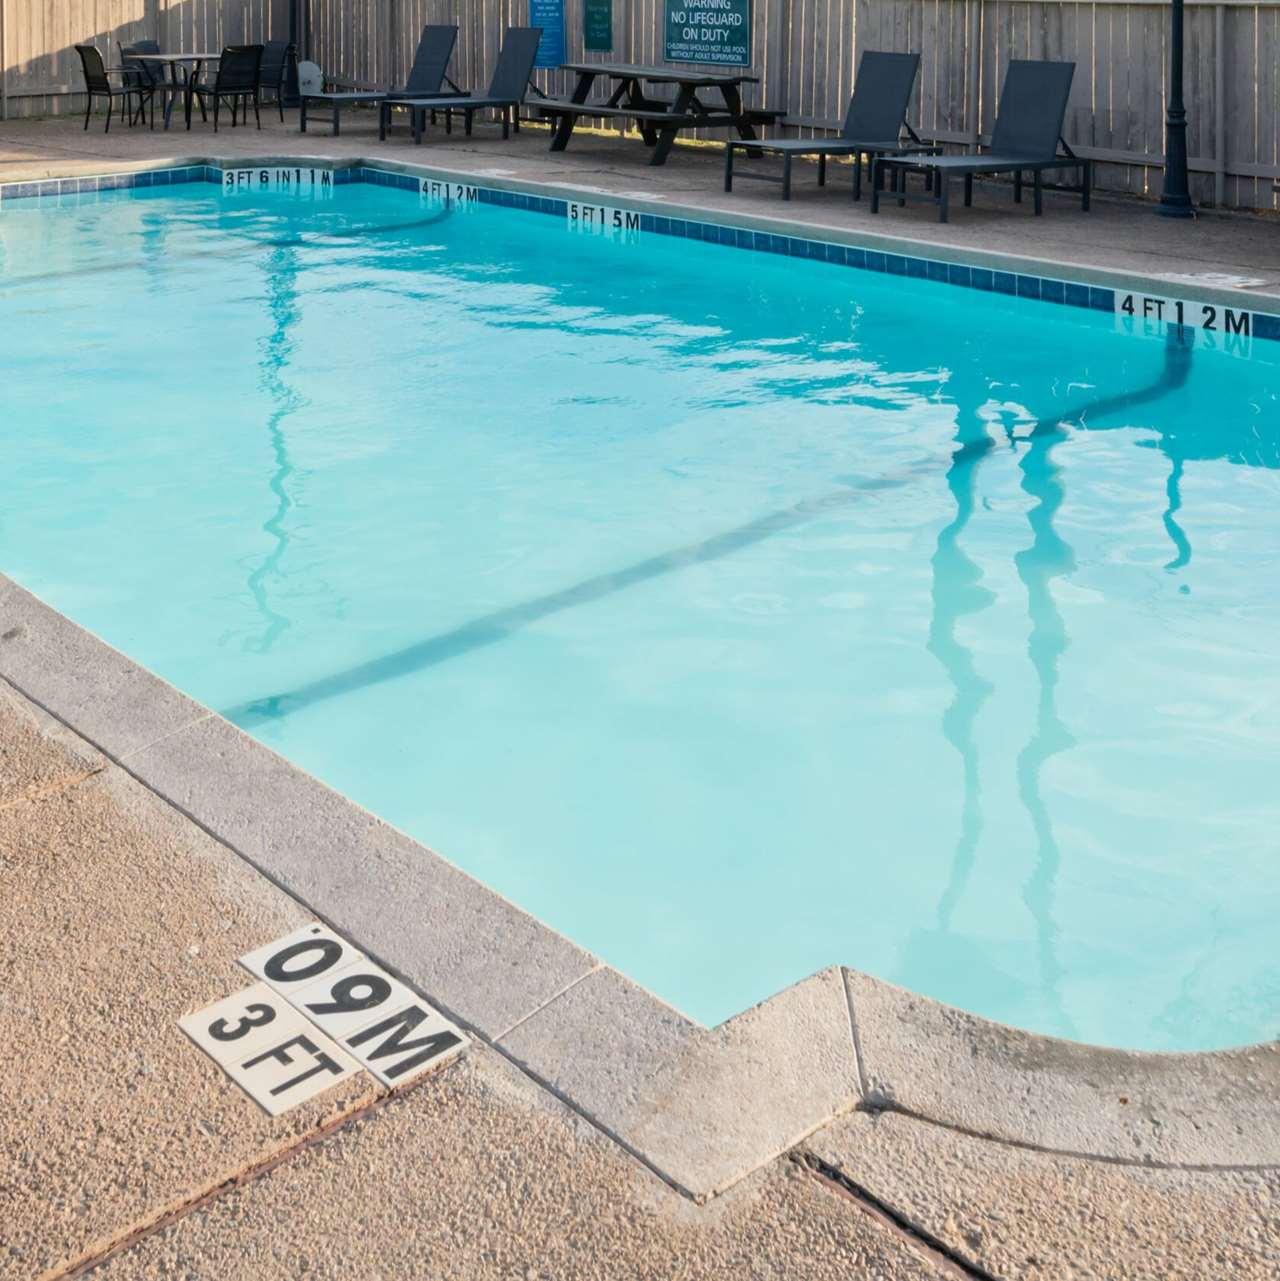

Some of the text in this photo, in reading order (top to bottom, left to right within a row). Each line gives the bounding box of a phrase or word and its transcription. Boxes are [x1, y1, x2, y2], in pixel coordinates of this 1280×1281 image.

[671, 11, 742, 26] NO LIFEGUARD
[682, 27, 730, 42] ON DUTY
[667, 42, 688, 50] CHILDREN
[711, 44, 721, 52] NOT
[722, 45, 731, 53] USE
[732, 46, 746, 54] POOL
[671, 50, 742, 61] WITHOUT ADULT SUPERVISION
[226, 172, 234, 185] 3
[237, 170, 253, 184] FT
[260, 170, 269, 183] 6
[276, 170, 290, 183] IN
[431, 182, 442, 198] FT
[570, 204, 578, 220] 5
[582, 206, 595, 222] FT
[1122, 295, 1135, 316] 4
[1143, 297, 1165, 320] FT
[208, 1003, 345, 1096] 3 FT
